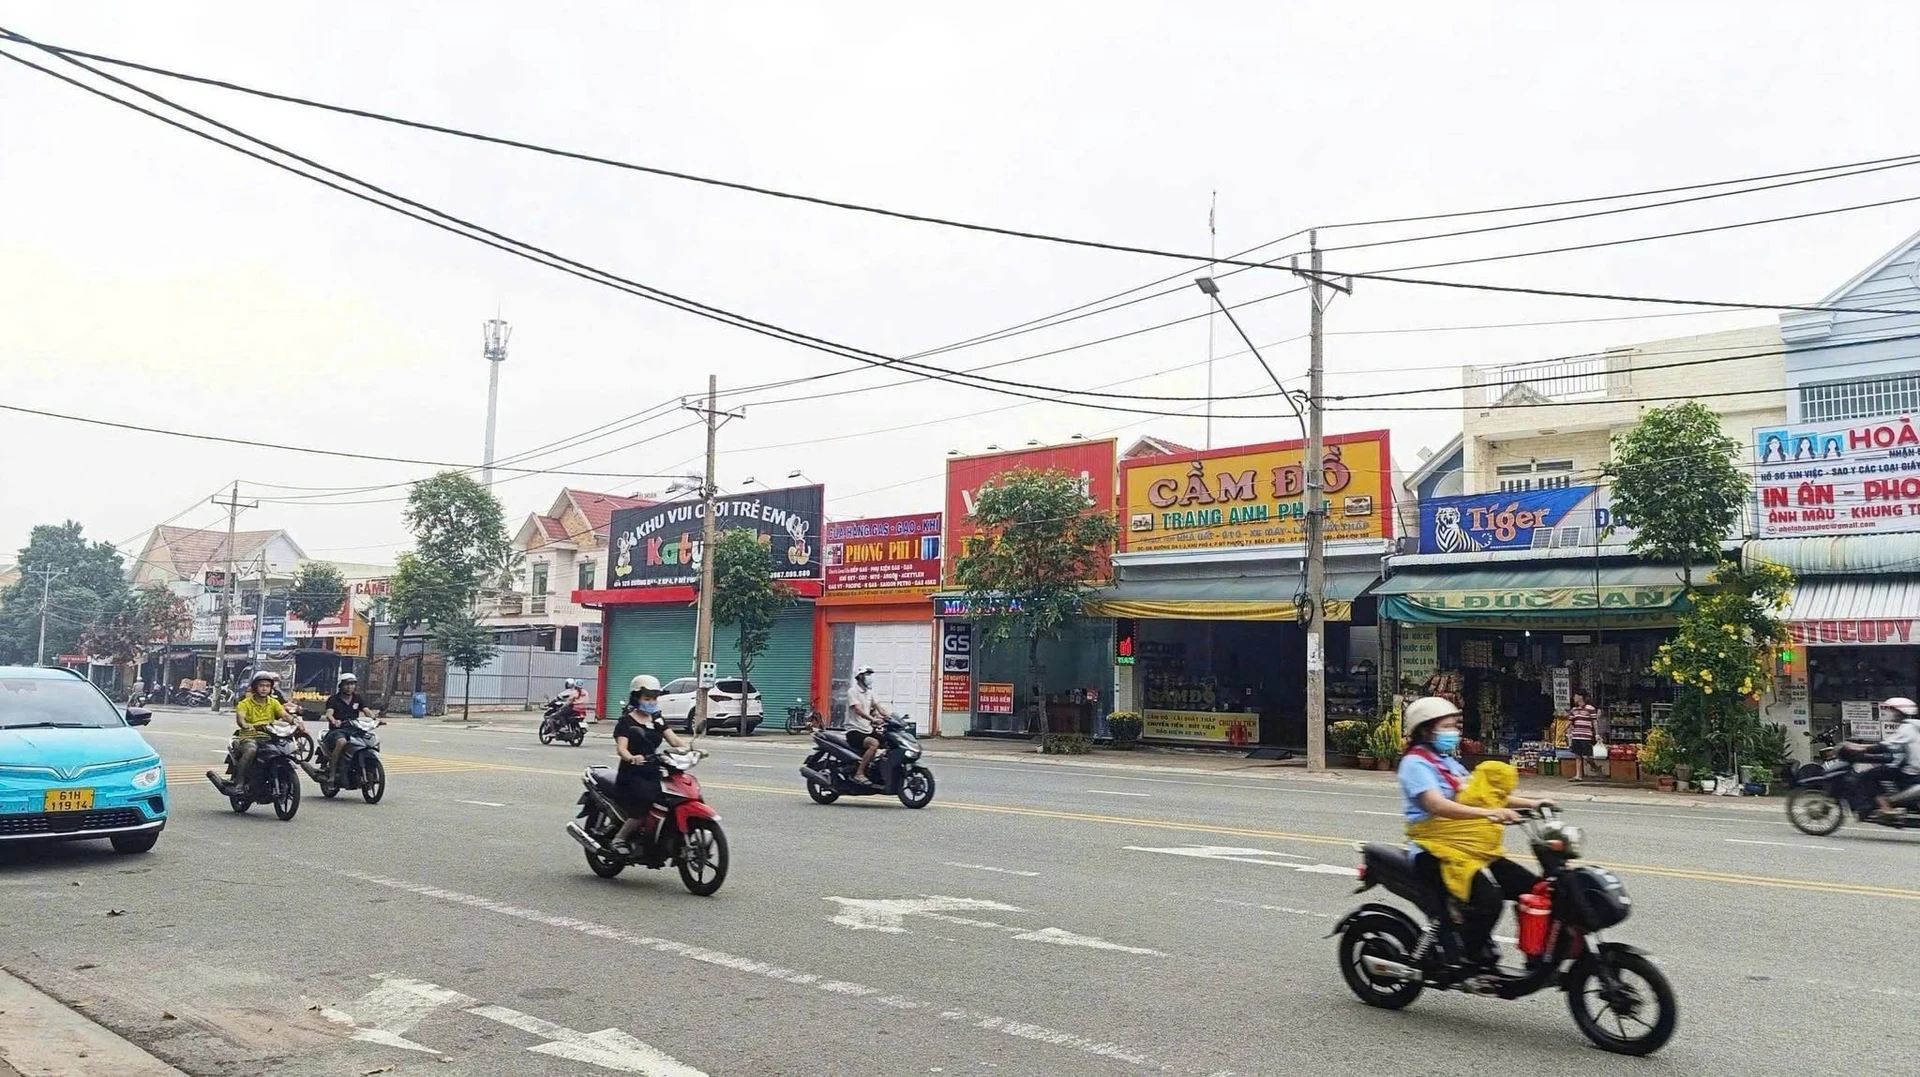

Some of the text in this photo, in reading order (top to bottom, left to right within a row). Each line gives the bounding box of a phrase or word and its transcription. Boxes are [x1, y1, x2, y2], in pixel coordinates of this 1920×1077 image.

[1889, 447, 1914, 458] NHẬN
[1148, 461, 1258, 508] CẦM
[1272, 445, 1351, 498] ĐỒ
[1806, 467, 1823, 479] VIỆC
[1832, 466, 1848, 475] SAO
[1859, 464, 1877, 474] CÁC
[1879, 463, 1899, 473] LOẠI
[1763, 486, 1789, 508] IN
[1797, 480, 1834, 505] ẤN
[636, 498, 787, 540] KHU VUI CƠI TRẺ EM
[1161, 498, 1331, 530] TRANG ANH PHT
[1466, 501, 1552, 542] Tiger
[1768, 509, 1798, 523] ẢNH
[1802, 507, 1835, 522] MÀU
[1851, 504, 1903, 518] KHUNG
[846, 523, 870, 539] HÀNG
[872, 523, 890, 536] GAS
[896, 520, 916, 536] GẠO
[922, 515, 940, 533] KHÍ
[845, 542, 884, 563] PHONG
[888, 540, 910, 560] PHI
[1572, 588, 1683, 608] SAN
[945, 634, 970, 652] GS
[60, 791, 81, 800] 61H
